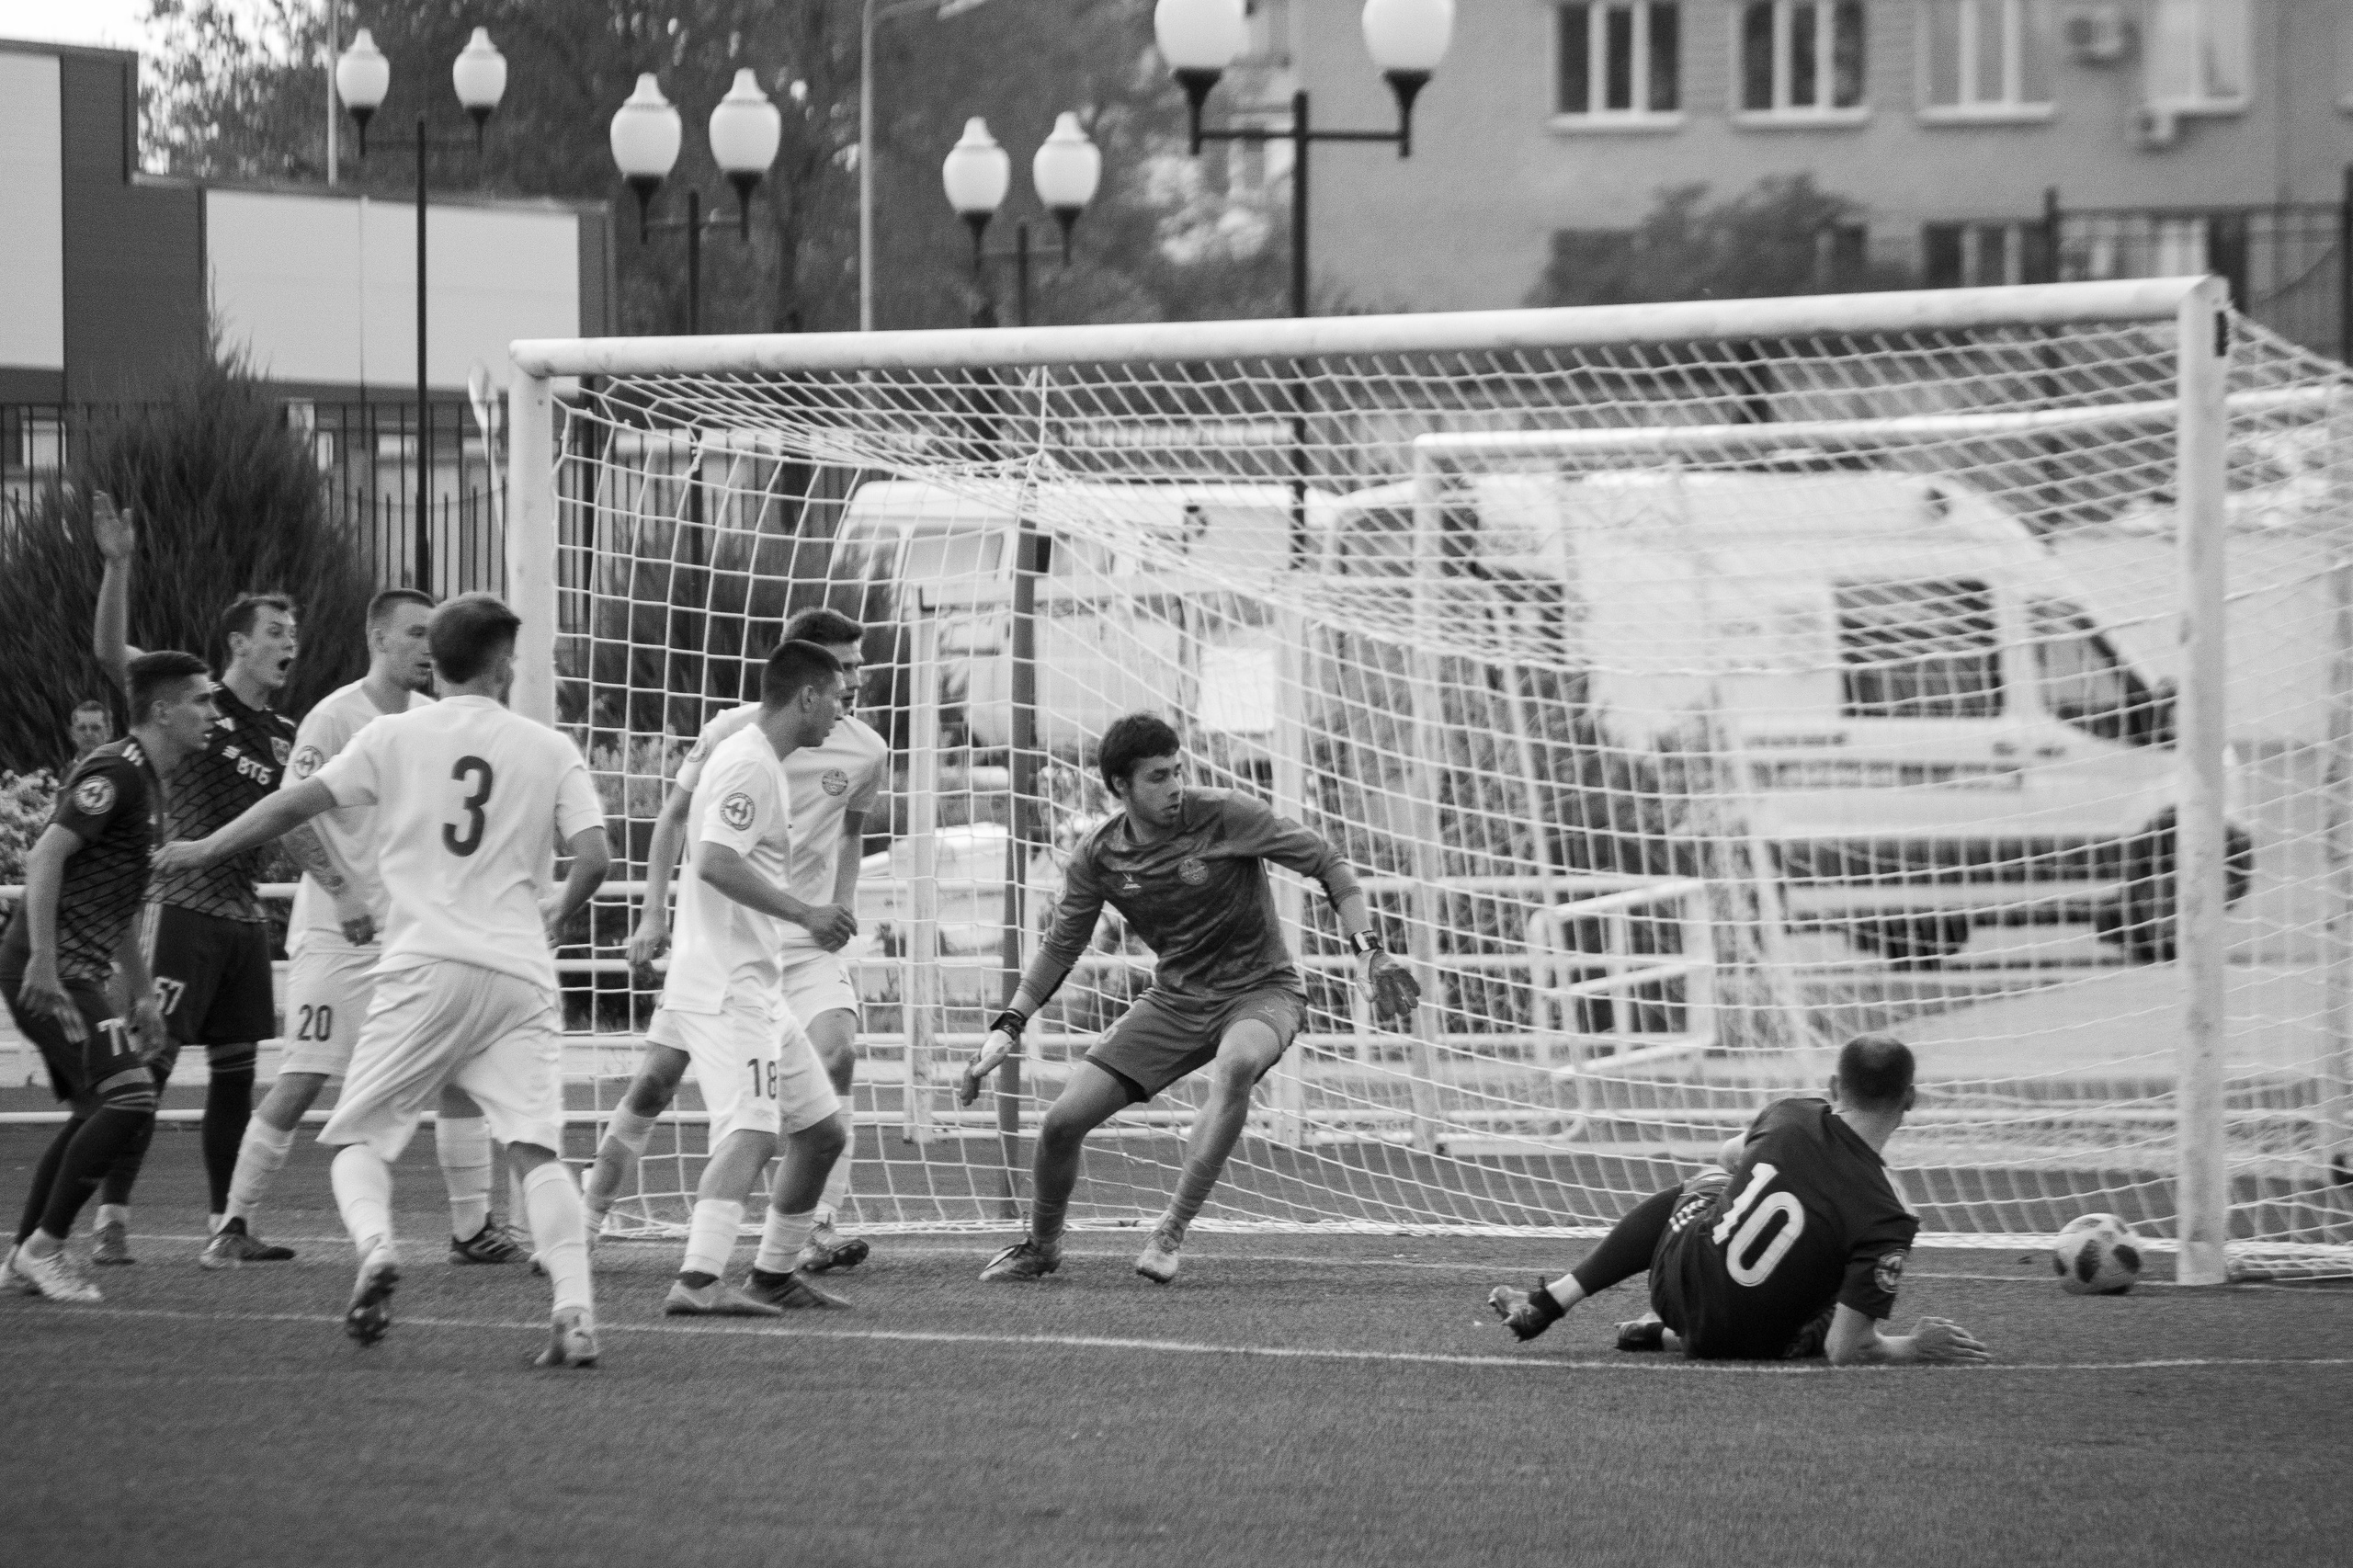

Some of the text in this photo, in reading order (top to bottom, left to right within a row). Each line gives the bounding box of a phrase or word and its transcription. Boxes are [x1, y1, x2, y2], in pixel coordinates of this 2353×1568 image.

[442, 756, 493, 857] 3
[297, 1004, 332, 1041] 20
[747, 1058, 777, 1100] 18
[1712, 1162, 1804, 1287] 10
